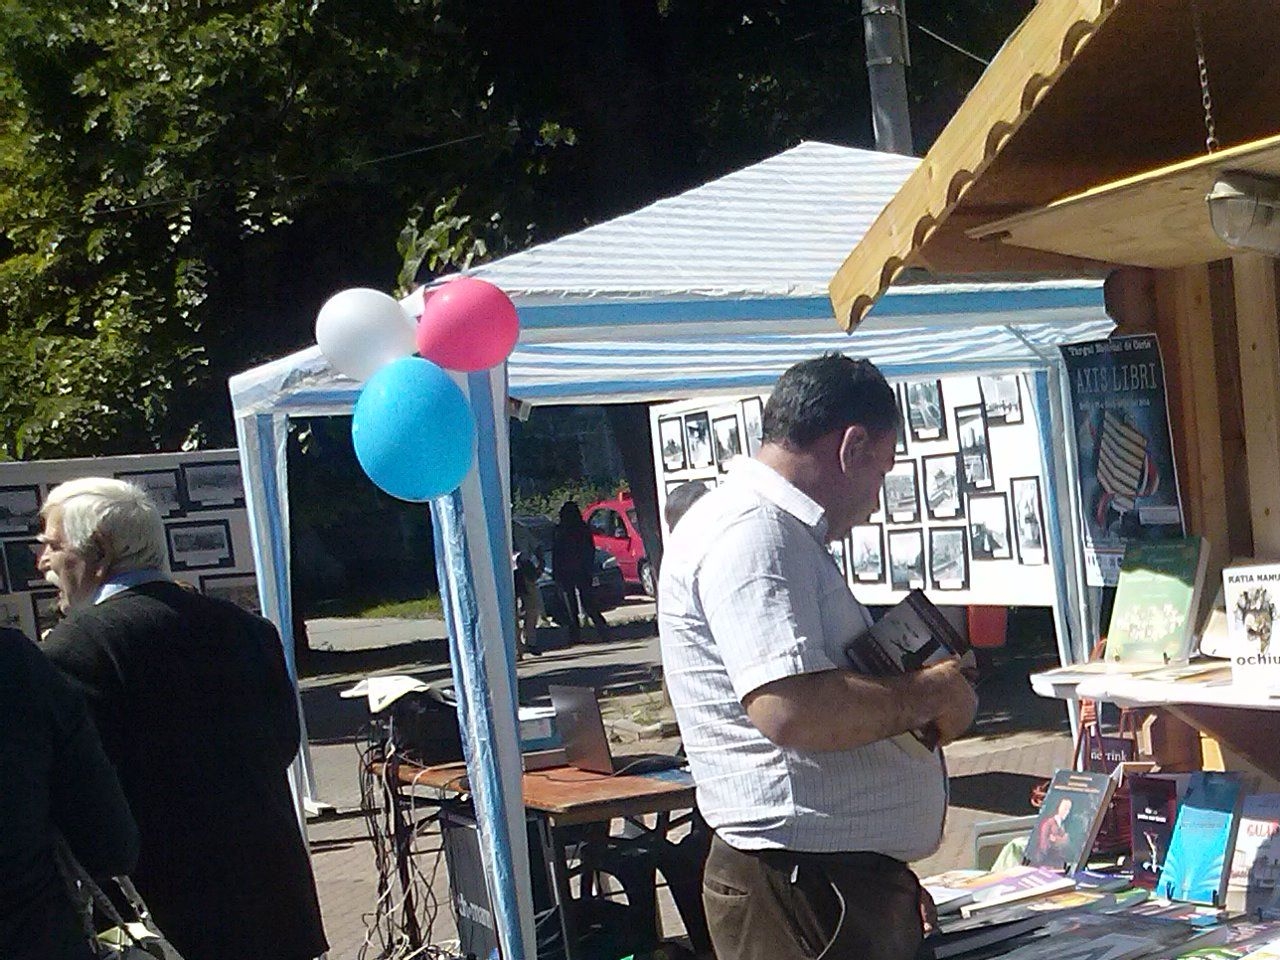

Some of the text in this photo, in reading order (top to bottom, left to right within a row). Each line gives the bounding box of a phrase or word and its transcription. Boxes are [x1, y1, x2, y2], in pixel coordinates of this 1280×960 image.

[1076, 362, 1158, 394] AXIS LIBRI
[1228, 574, 1255, 584] KATIA
